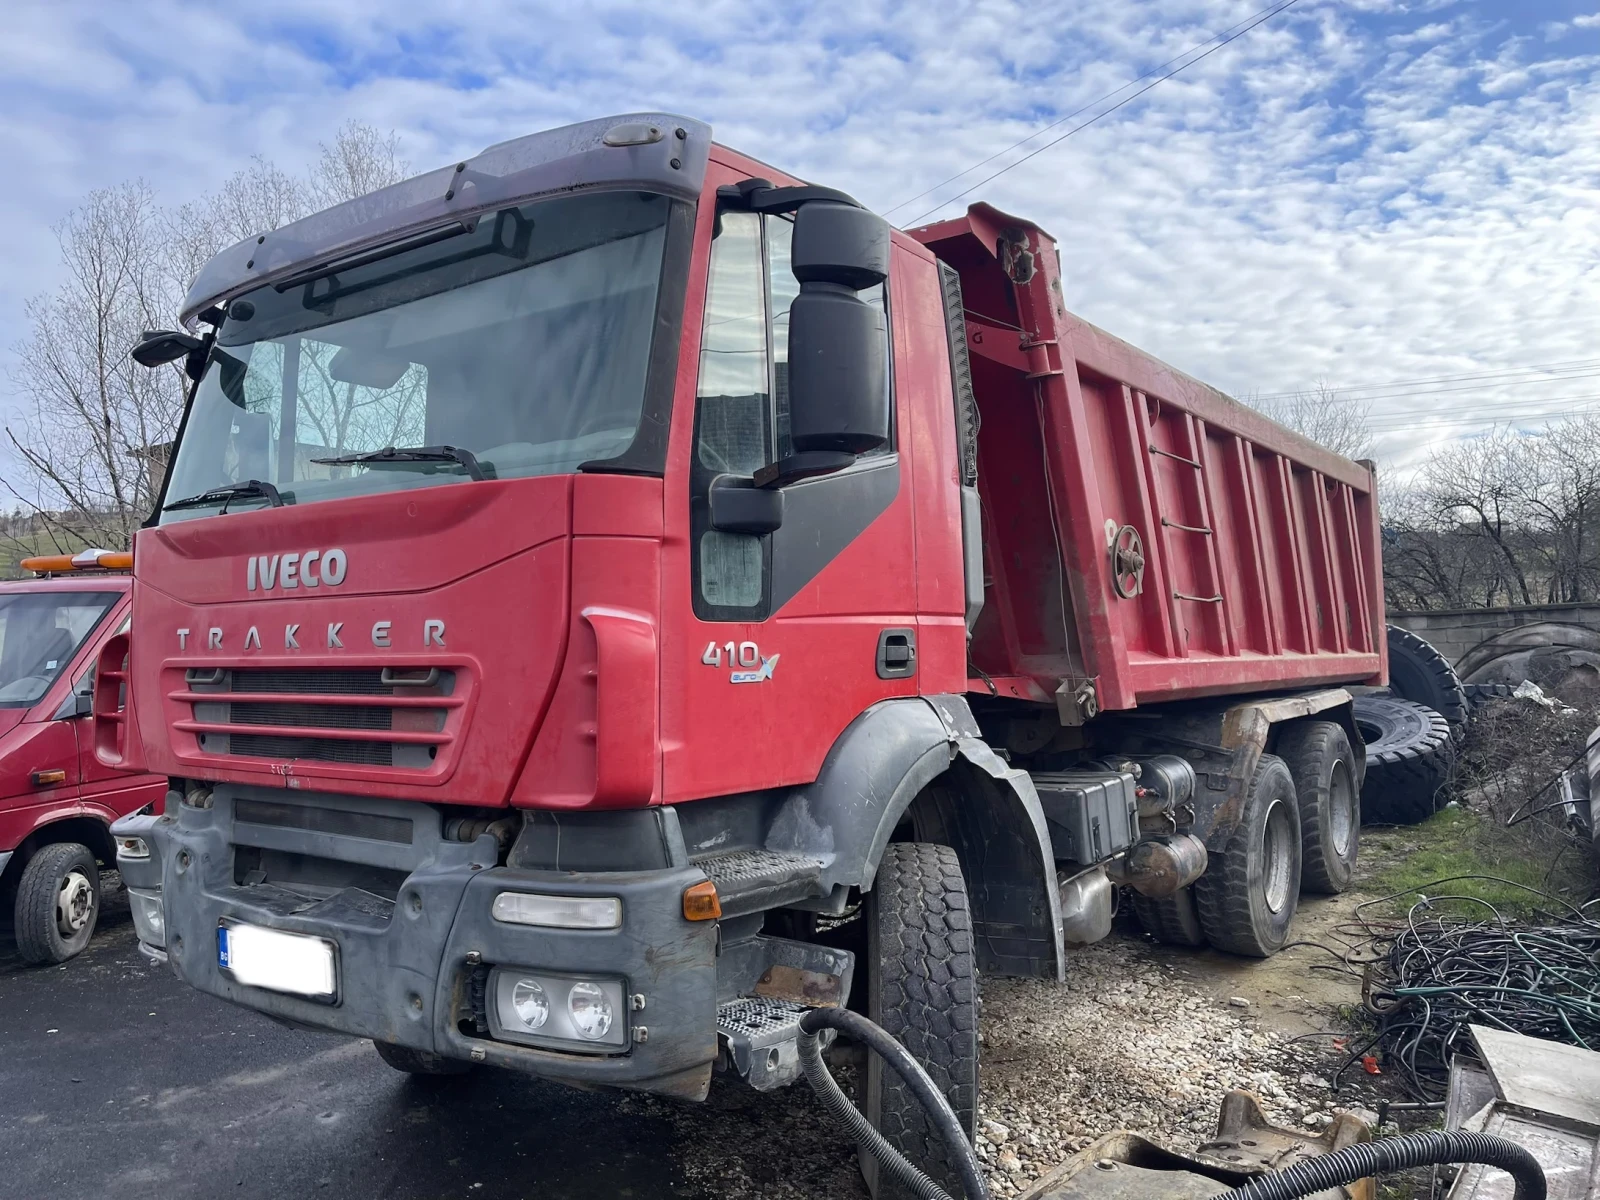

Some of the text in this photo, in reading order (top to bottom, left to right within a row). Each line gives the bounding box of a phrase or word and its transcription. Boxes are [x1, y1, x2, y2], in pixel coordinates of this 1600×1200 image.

[247, 549, 347, 590] IVECO
[176, 619, 446, 649] TRAKKER
[702, 641, 758, 667] 410
